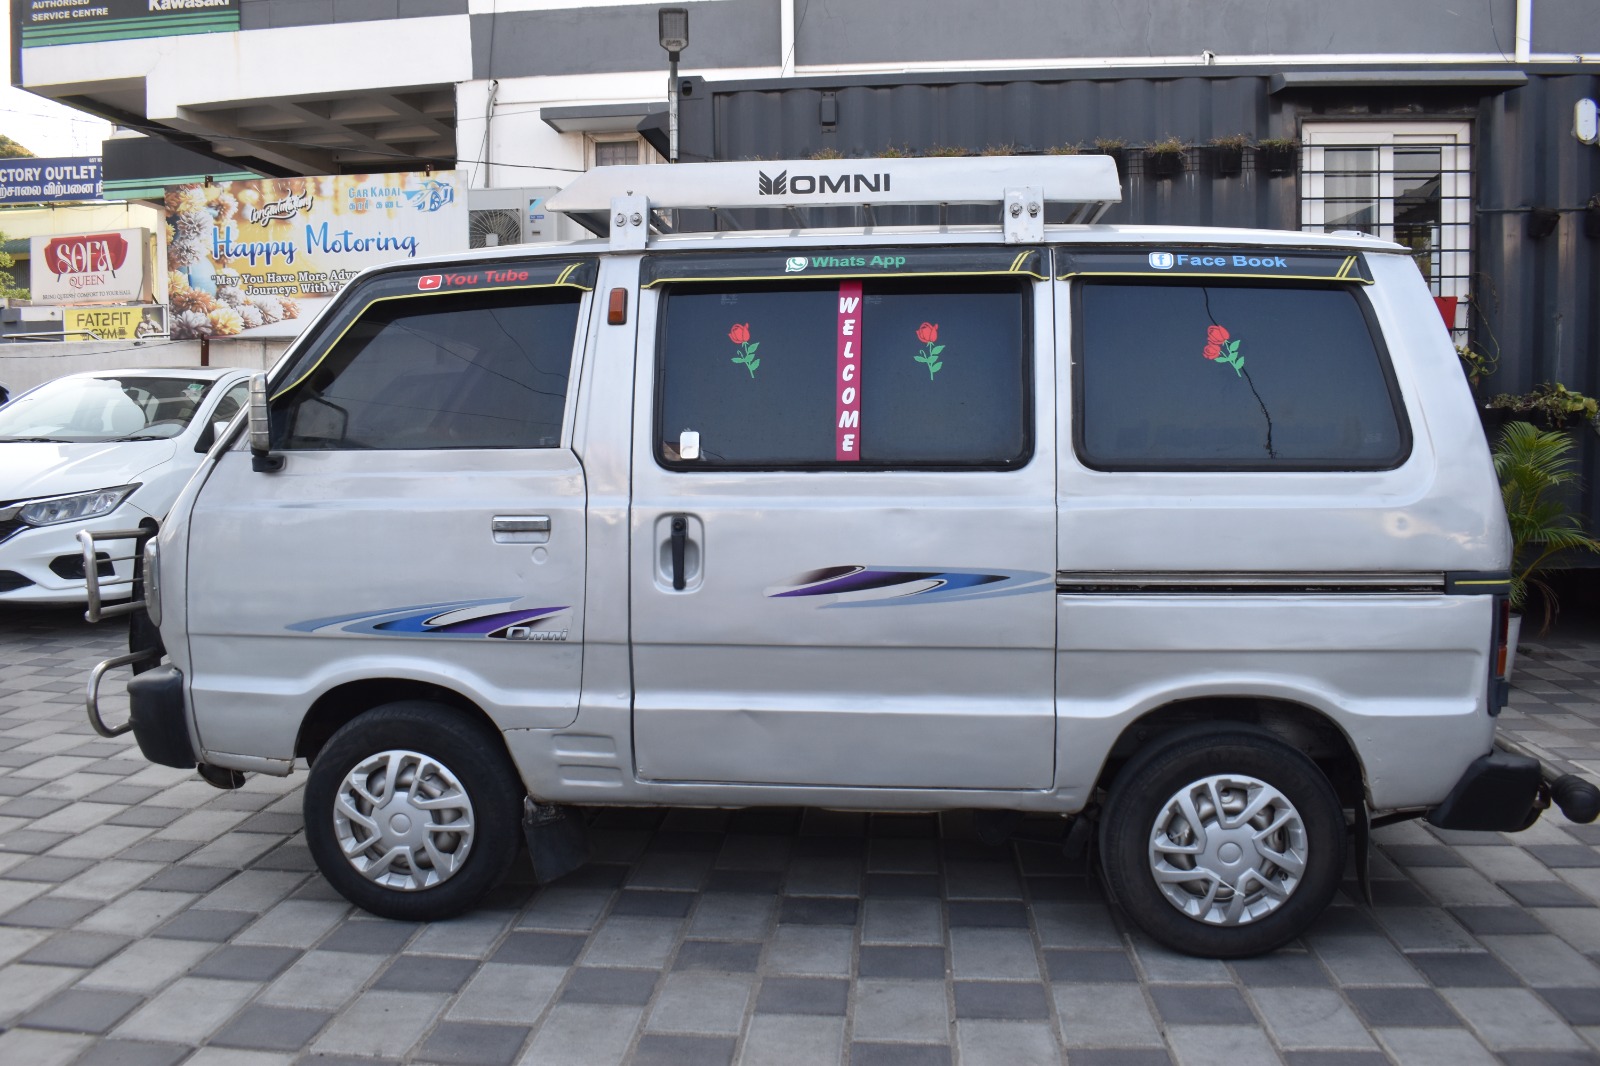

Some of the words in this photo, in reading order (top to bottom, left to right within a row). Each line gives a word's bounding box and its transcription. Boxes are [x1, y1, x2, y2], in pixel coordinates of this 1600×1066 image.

[32, 0, 90, 9] AUTHORISED
[32, 11, 70, 21] SERVICE
[72, 8, 109, 18] CENTRE
[0, 168, 41, 182] CTORY
[45, 166, 97, 180] OUTLET
[43, 181, 94, 198] விற்பனை
[790, 173, 891, 194] OMNI
[370, 186, 401, 197] KADAI
[211, 225, 298, 266] Happy
[305, 220, 420, 258] Motoring
[56, 240, 113, 274] SOFA
[812, 256, 865, 268] Whats
[870, 255, 906, 269] App
[1177, 254, 1226, 266] Face
[1232, 256, 1287, 268] Book
[69, 274, 105, 289] QUEEN
[242, 274, 266, 284] You
[267, 273, 295, 283] Have
[298, 271, 327, 282] More
[445, 275, 478, 286] You
[485, 269, 529, 283] Tube
[245, 284, 298, 296] Journeys
[300, 282, 328, 293] With
[77, 312, 131, 327] FAT2FIT
[838, 297, 859, 452] WELCOME
[506, 626, 568, 641] Omni
